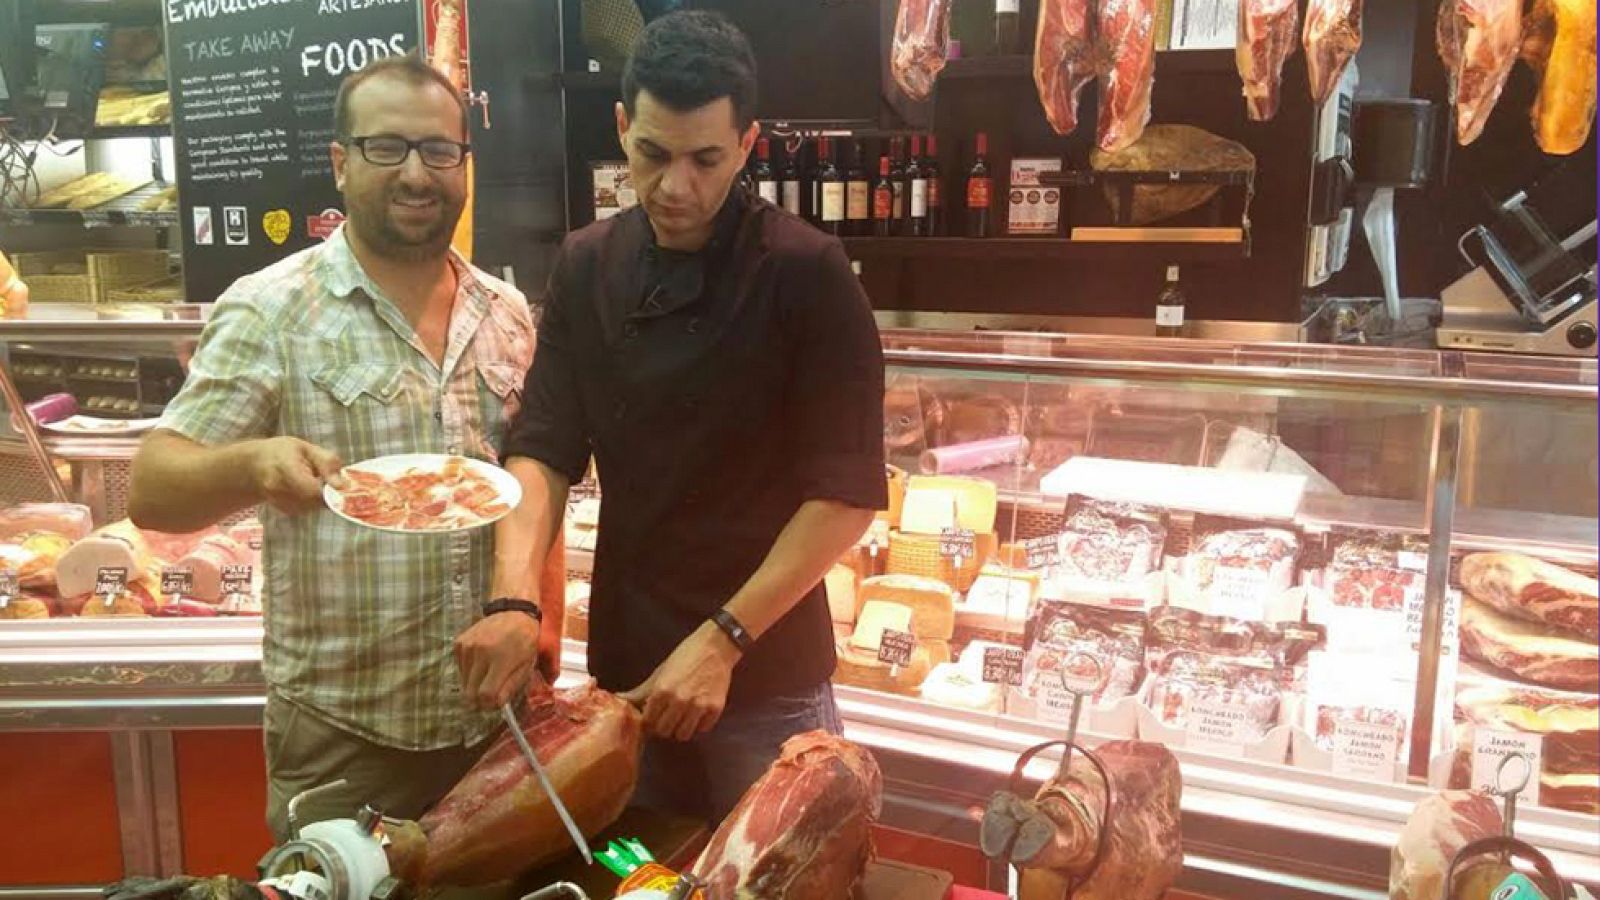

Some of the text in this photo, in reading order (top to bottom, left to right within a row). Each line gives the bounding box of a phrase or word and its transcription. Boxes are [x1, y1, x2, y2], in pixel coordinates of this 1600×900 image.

[184, 27, 295, 61] TAKE AWAY
[301, 33, 407, 77] FOODS
